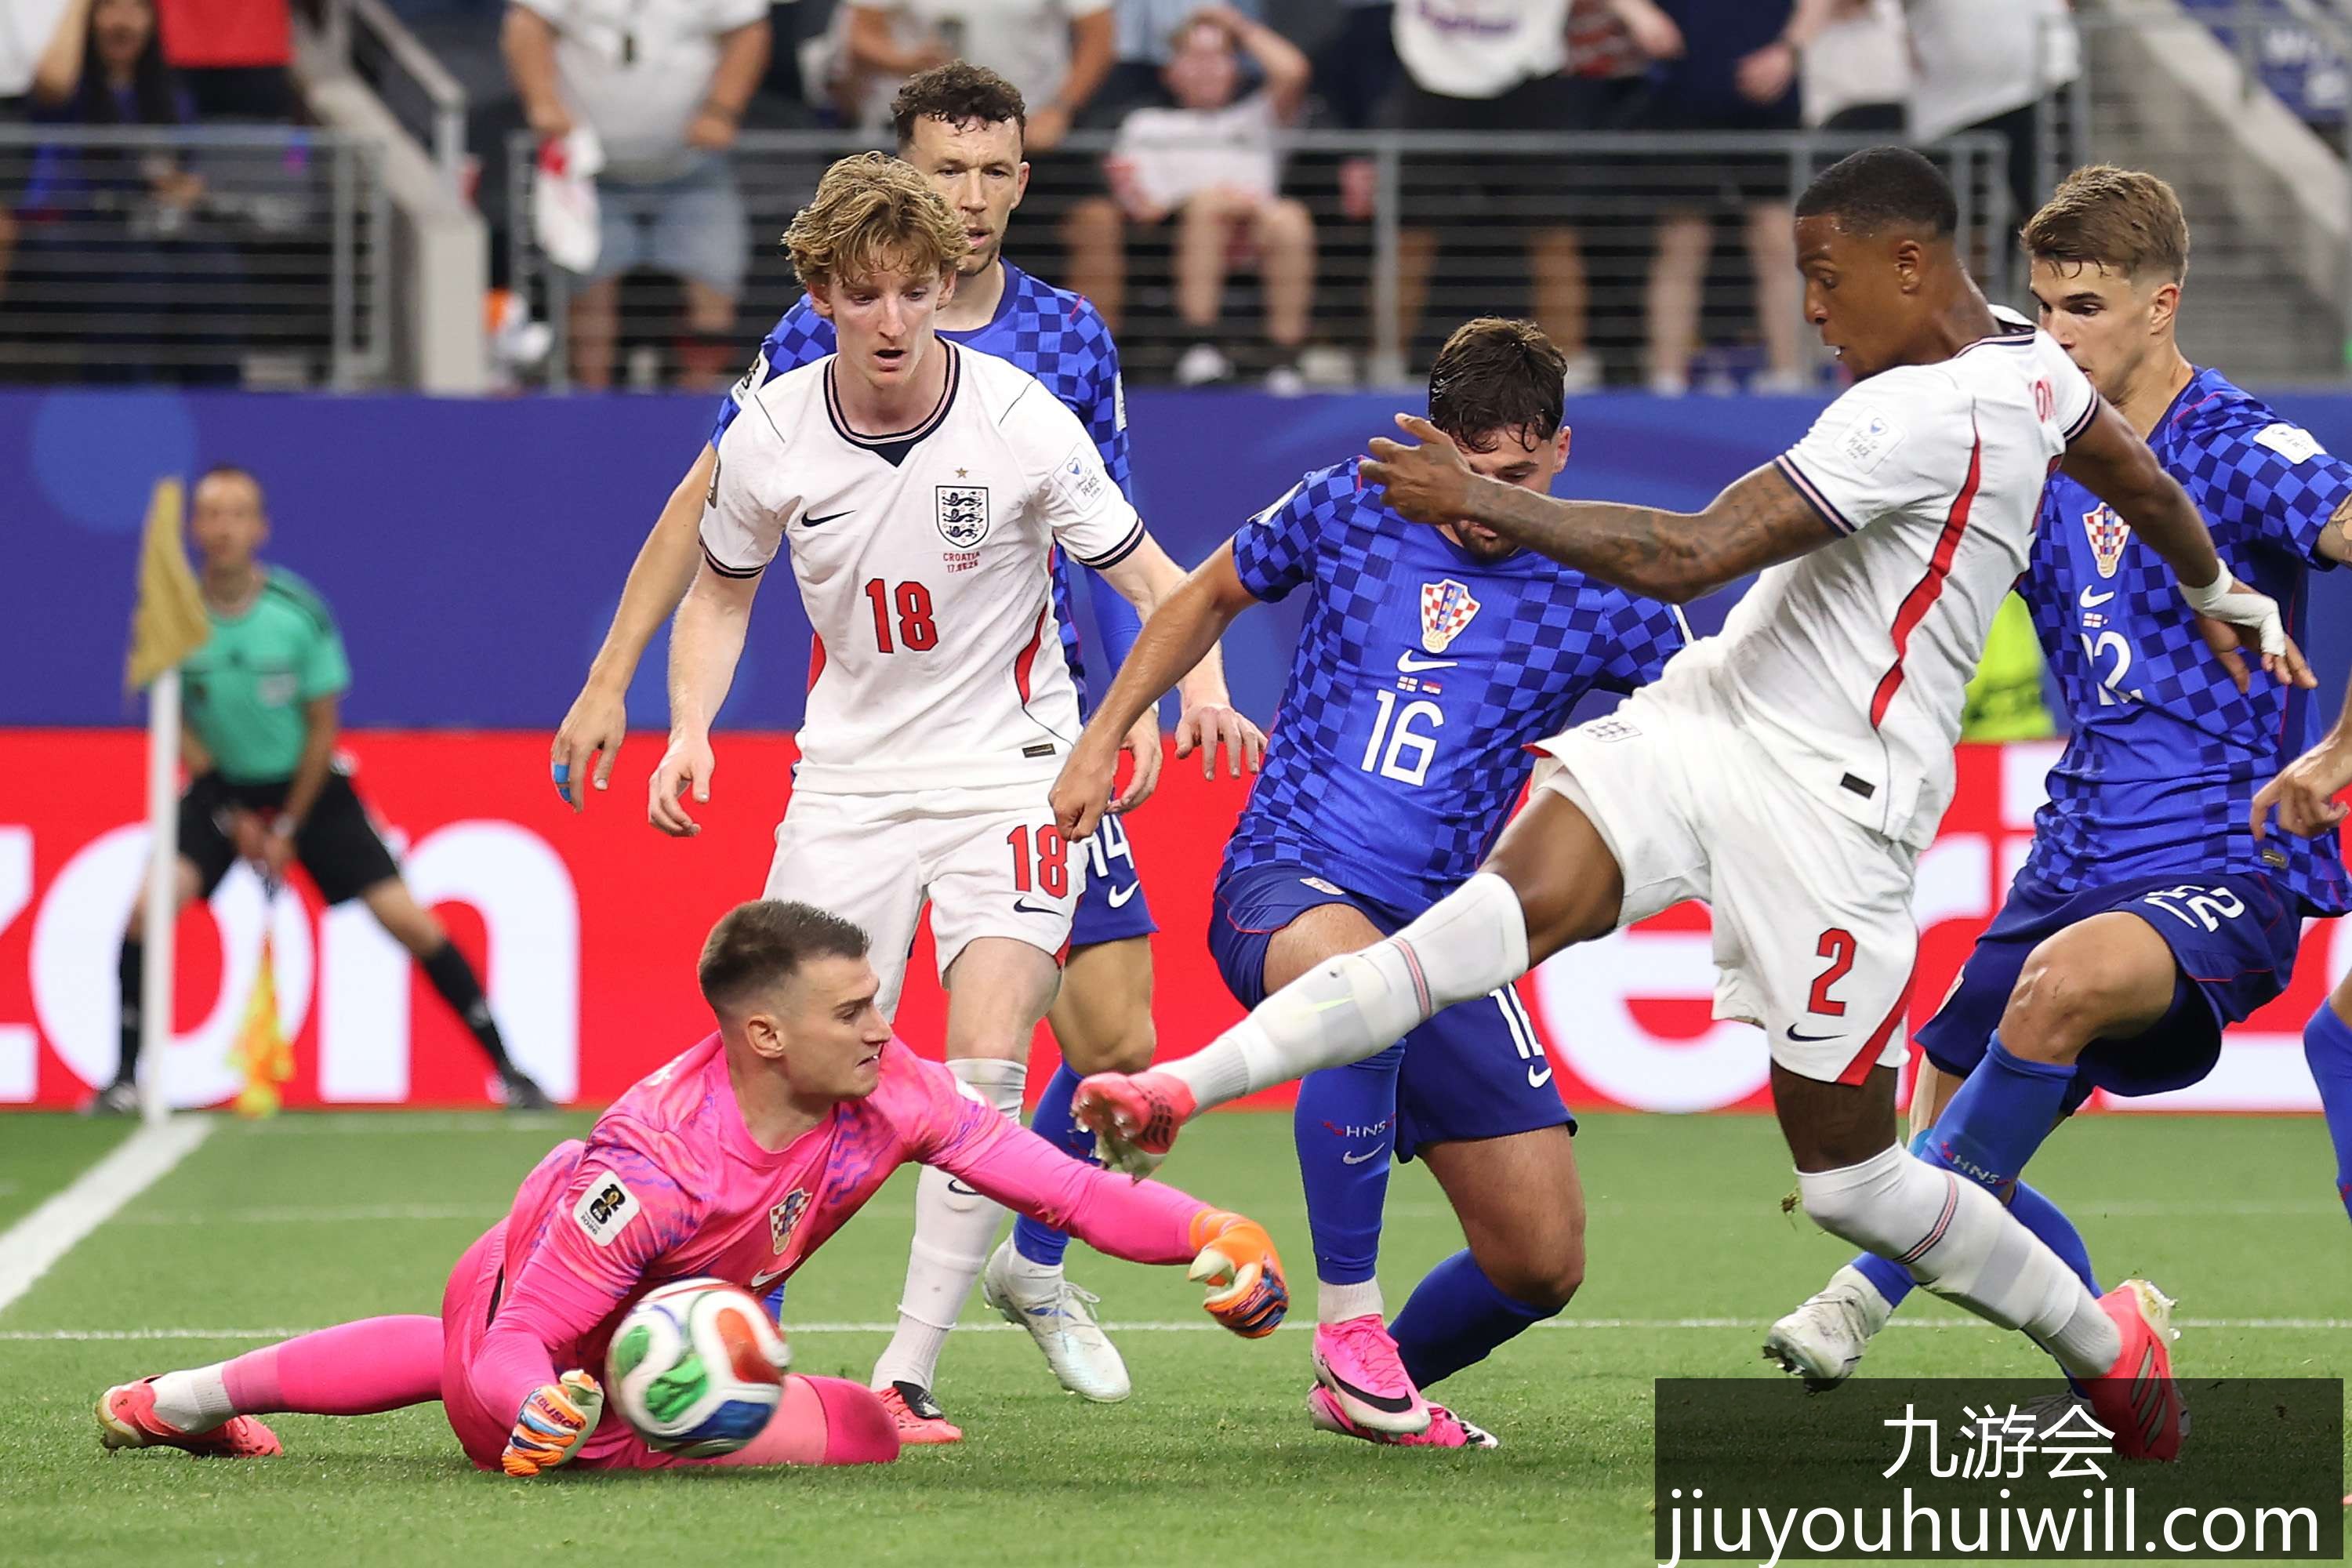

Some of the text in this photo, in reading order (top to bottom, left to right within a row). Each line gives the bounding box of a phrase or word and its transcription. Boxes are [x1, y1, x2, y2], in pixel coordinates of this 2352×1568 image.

[943, 551, 980, 561] CROATIA
[865, 577, 938, 654] 18
[1360, 689, 1444, 787] 16
[1007, 823, 1068, 899] 18
[1090, 814, 1135, 877] 14
[0, 818, 582, 1107] on
[1807, 927, 1857, 1017] 2
[1346, 1120, 1386, 1138] HNS
[1952, 1154, 2000, 1185] HNS
